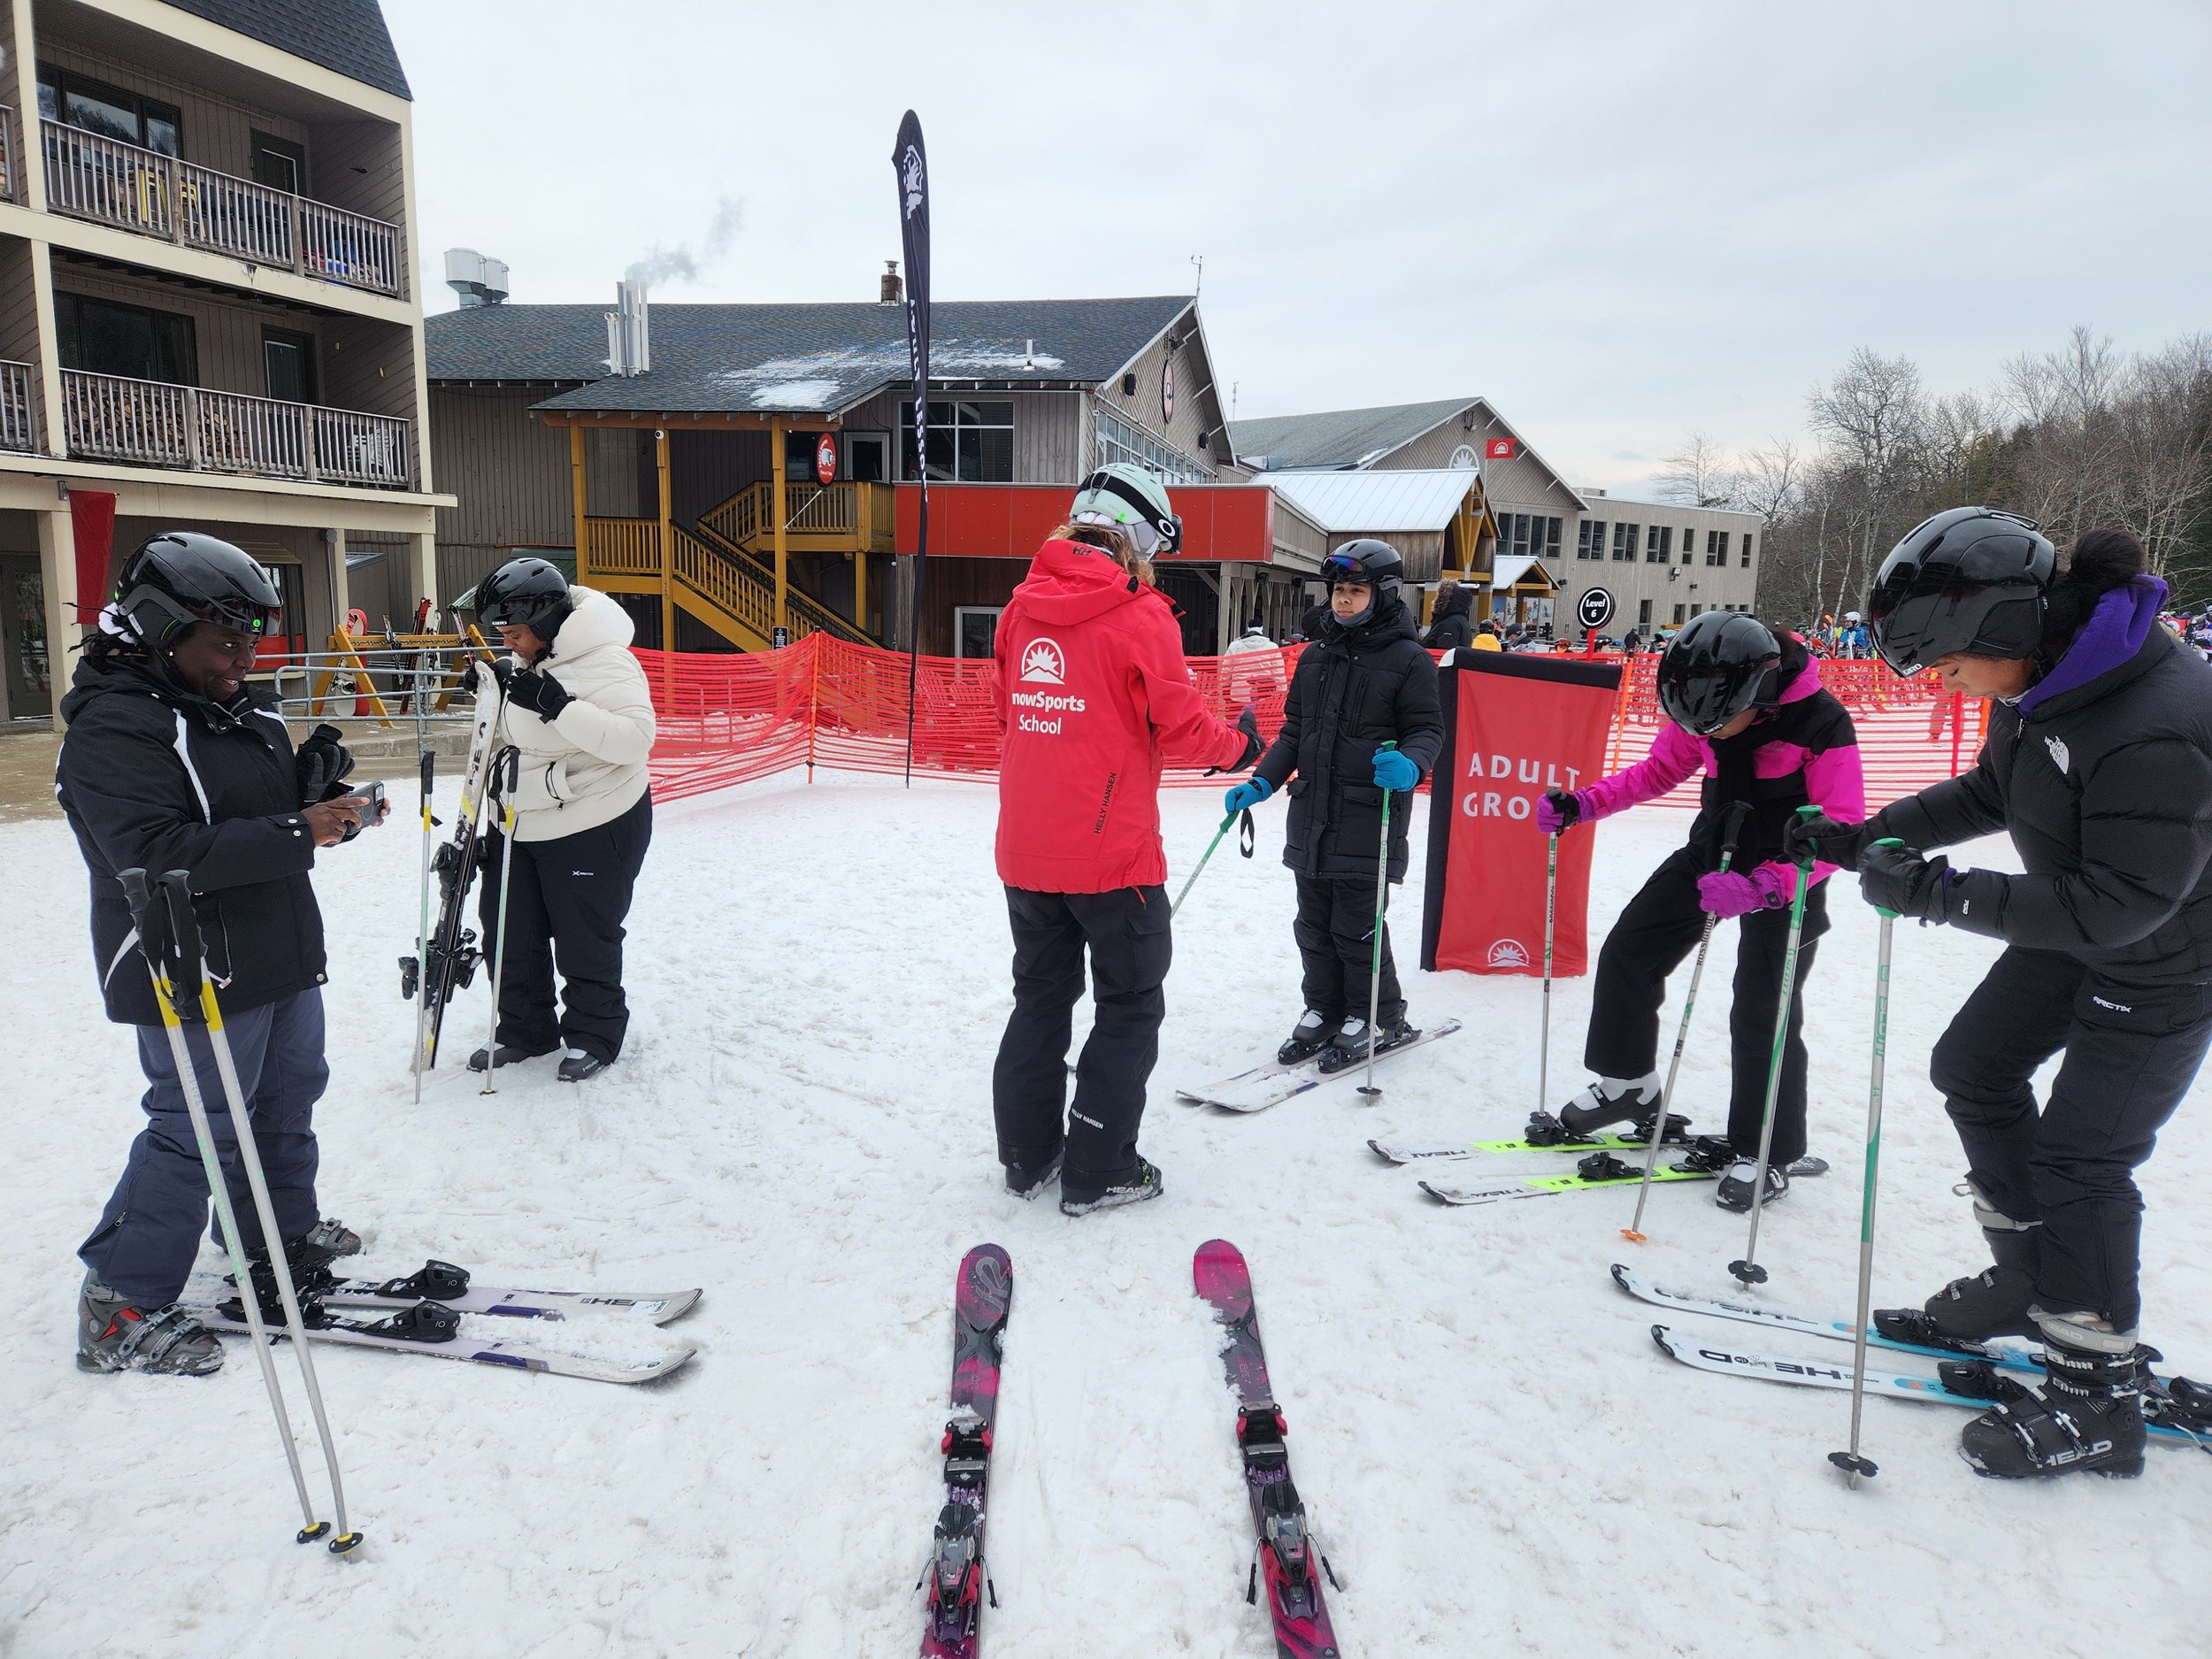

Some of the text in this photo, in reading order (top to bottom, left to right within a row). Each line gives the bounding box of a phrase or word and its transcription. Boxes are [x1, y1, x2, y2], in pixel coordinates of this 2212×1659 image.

[1072, 545, 1092, 557] HH
[1586, 598, 1606, 608] Level
[1590, 609, 1598, 619] 6
[1902, 663, 1924, 675] GIRO
[1011, 690, 1087, 713] nowSports
[1018, 713, 1062, 735] School
[1468, 752, 1581, 792] ADULT
[1094, 772, 1118, 834] HELLY HANSEN
[1462, 792, 1532, 820] GRO
[1353, 1037, 1371, 1048] HEA
[1082, 1114, 1104, 1130] HANSEN
[1699, 1348, 1842, 1380] HED
